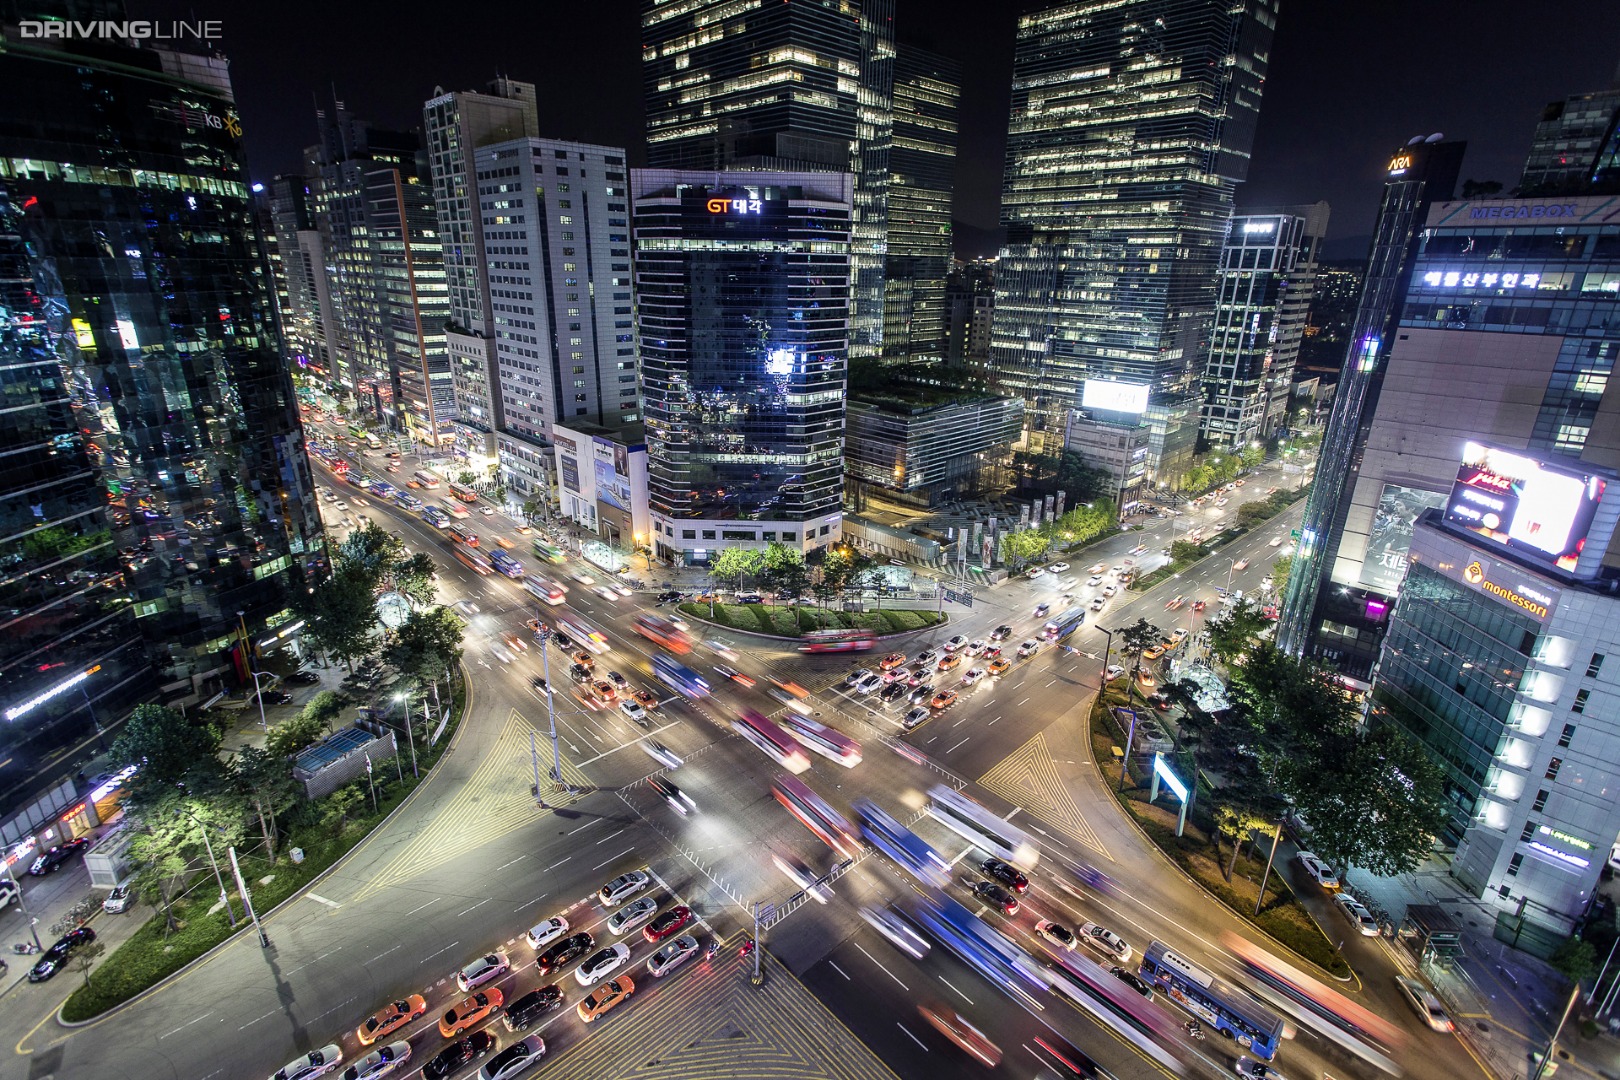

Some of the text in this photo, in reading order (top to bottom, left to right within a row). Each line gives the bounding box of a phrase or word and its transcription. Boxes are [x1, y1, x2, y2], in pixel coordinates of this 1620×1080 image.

[205, 113, 223, 130] KB
[1469, 203, 1578, 220] MEGABOX
[1482, 580, 1547, 618] montessori
